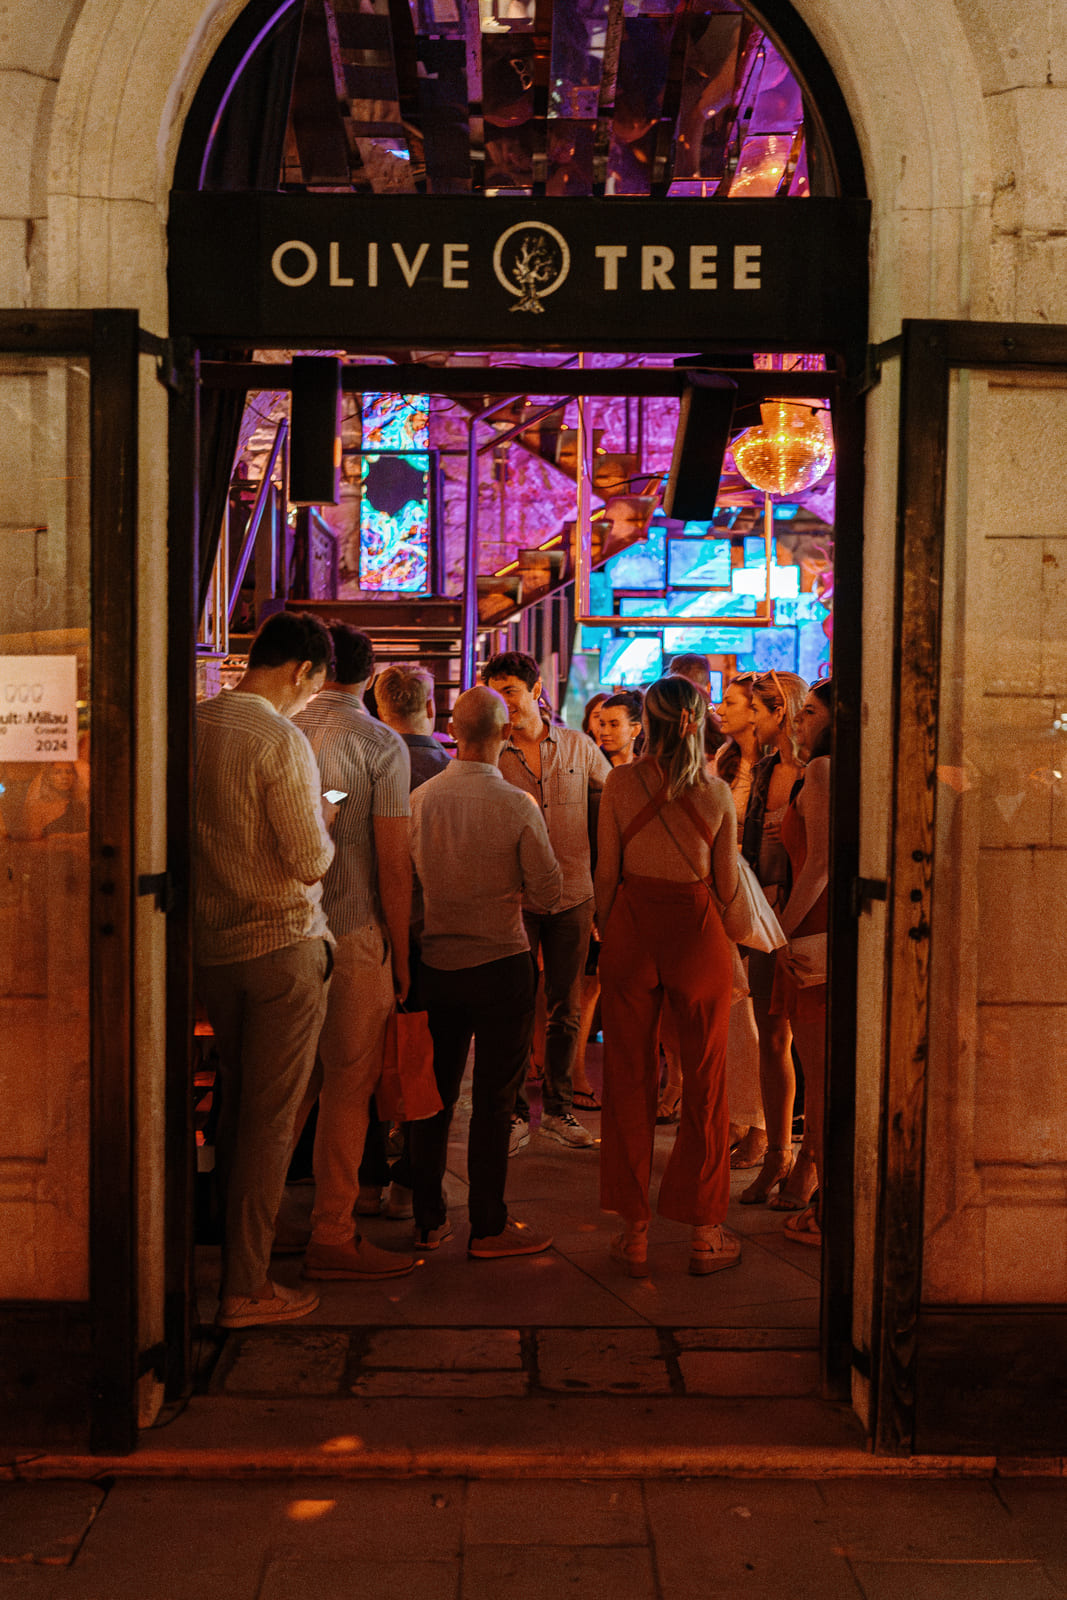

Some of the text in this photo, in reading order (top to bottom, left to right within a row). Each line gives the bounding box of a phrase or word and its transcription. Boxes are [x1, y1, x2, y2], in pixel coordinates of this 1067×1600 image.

[271, 240, 762, 290] OLIVE TREE
[36, 740, 67, 751] 2024
